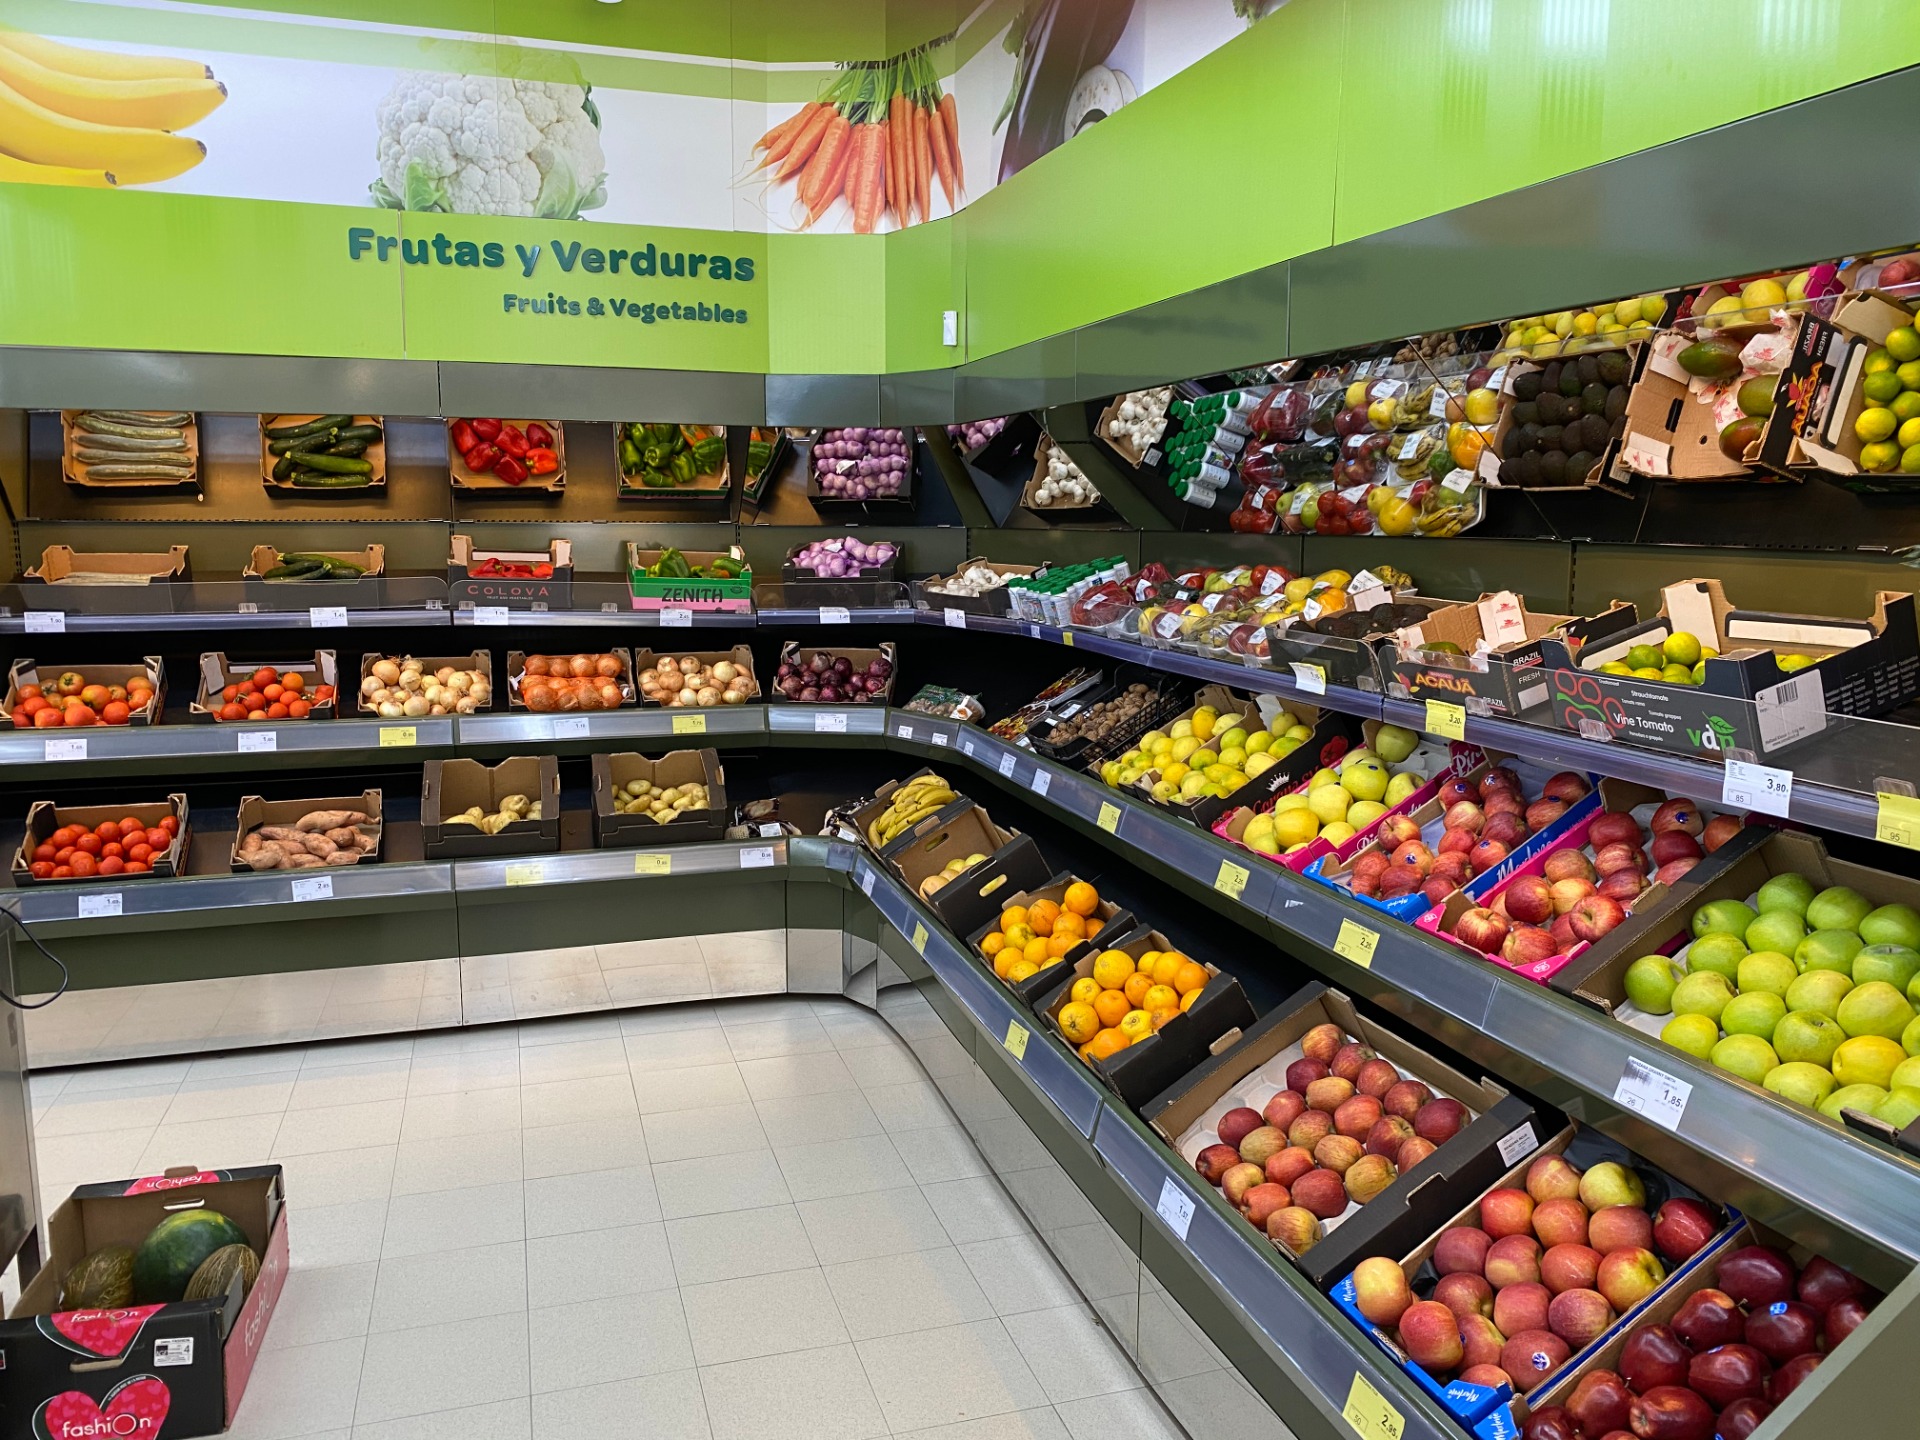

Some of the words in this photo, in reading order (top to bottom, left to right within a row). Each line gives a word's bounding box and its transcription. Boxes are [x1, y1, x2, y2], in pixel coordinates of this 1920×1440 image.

[348, 227, 505, 268] Frutas
[515, 244, 541, 278] y
[550, 240, 754, 282] Verduras
[503, 292, 581, 316] Fruits
[587, 297, 606, 316] &
[610, 298, 749, 324] Vegetables
[467, 585, 549, 596] COLOVA
[661, 587, 723, 602] ZENITH
[1513, 650, 1541, 667] BRAZIL
[1414, 671, 1477, 696] ACAUÃ
[1518, 671, 1541, 685] FRESH
[1613, 712, 1635, 726] Vine
[1635, 717, 1674, 734] Tomato
[1735, 794, 1744, 803] 85
[1889, 831, 1900, 842] 95
[183, 1345, 190, 1353] 4
[1353, 1414, 1362, 1425] 50
